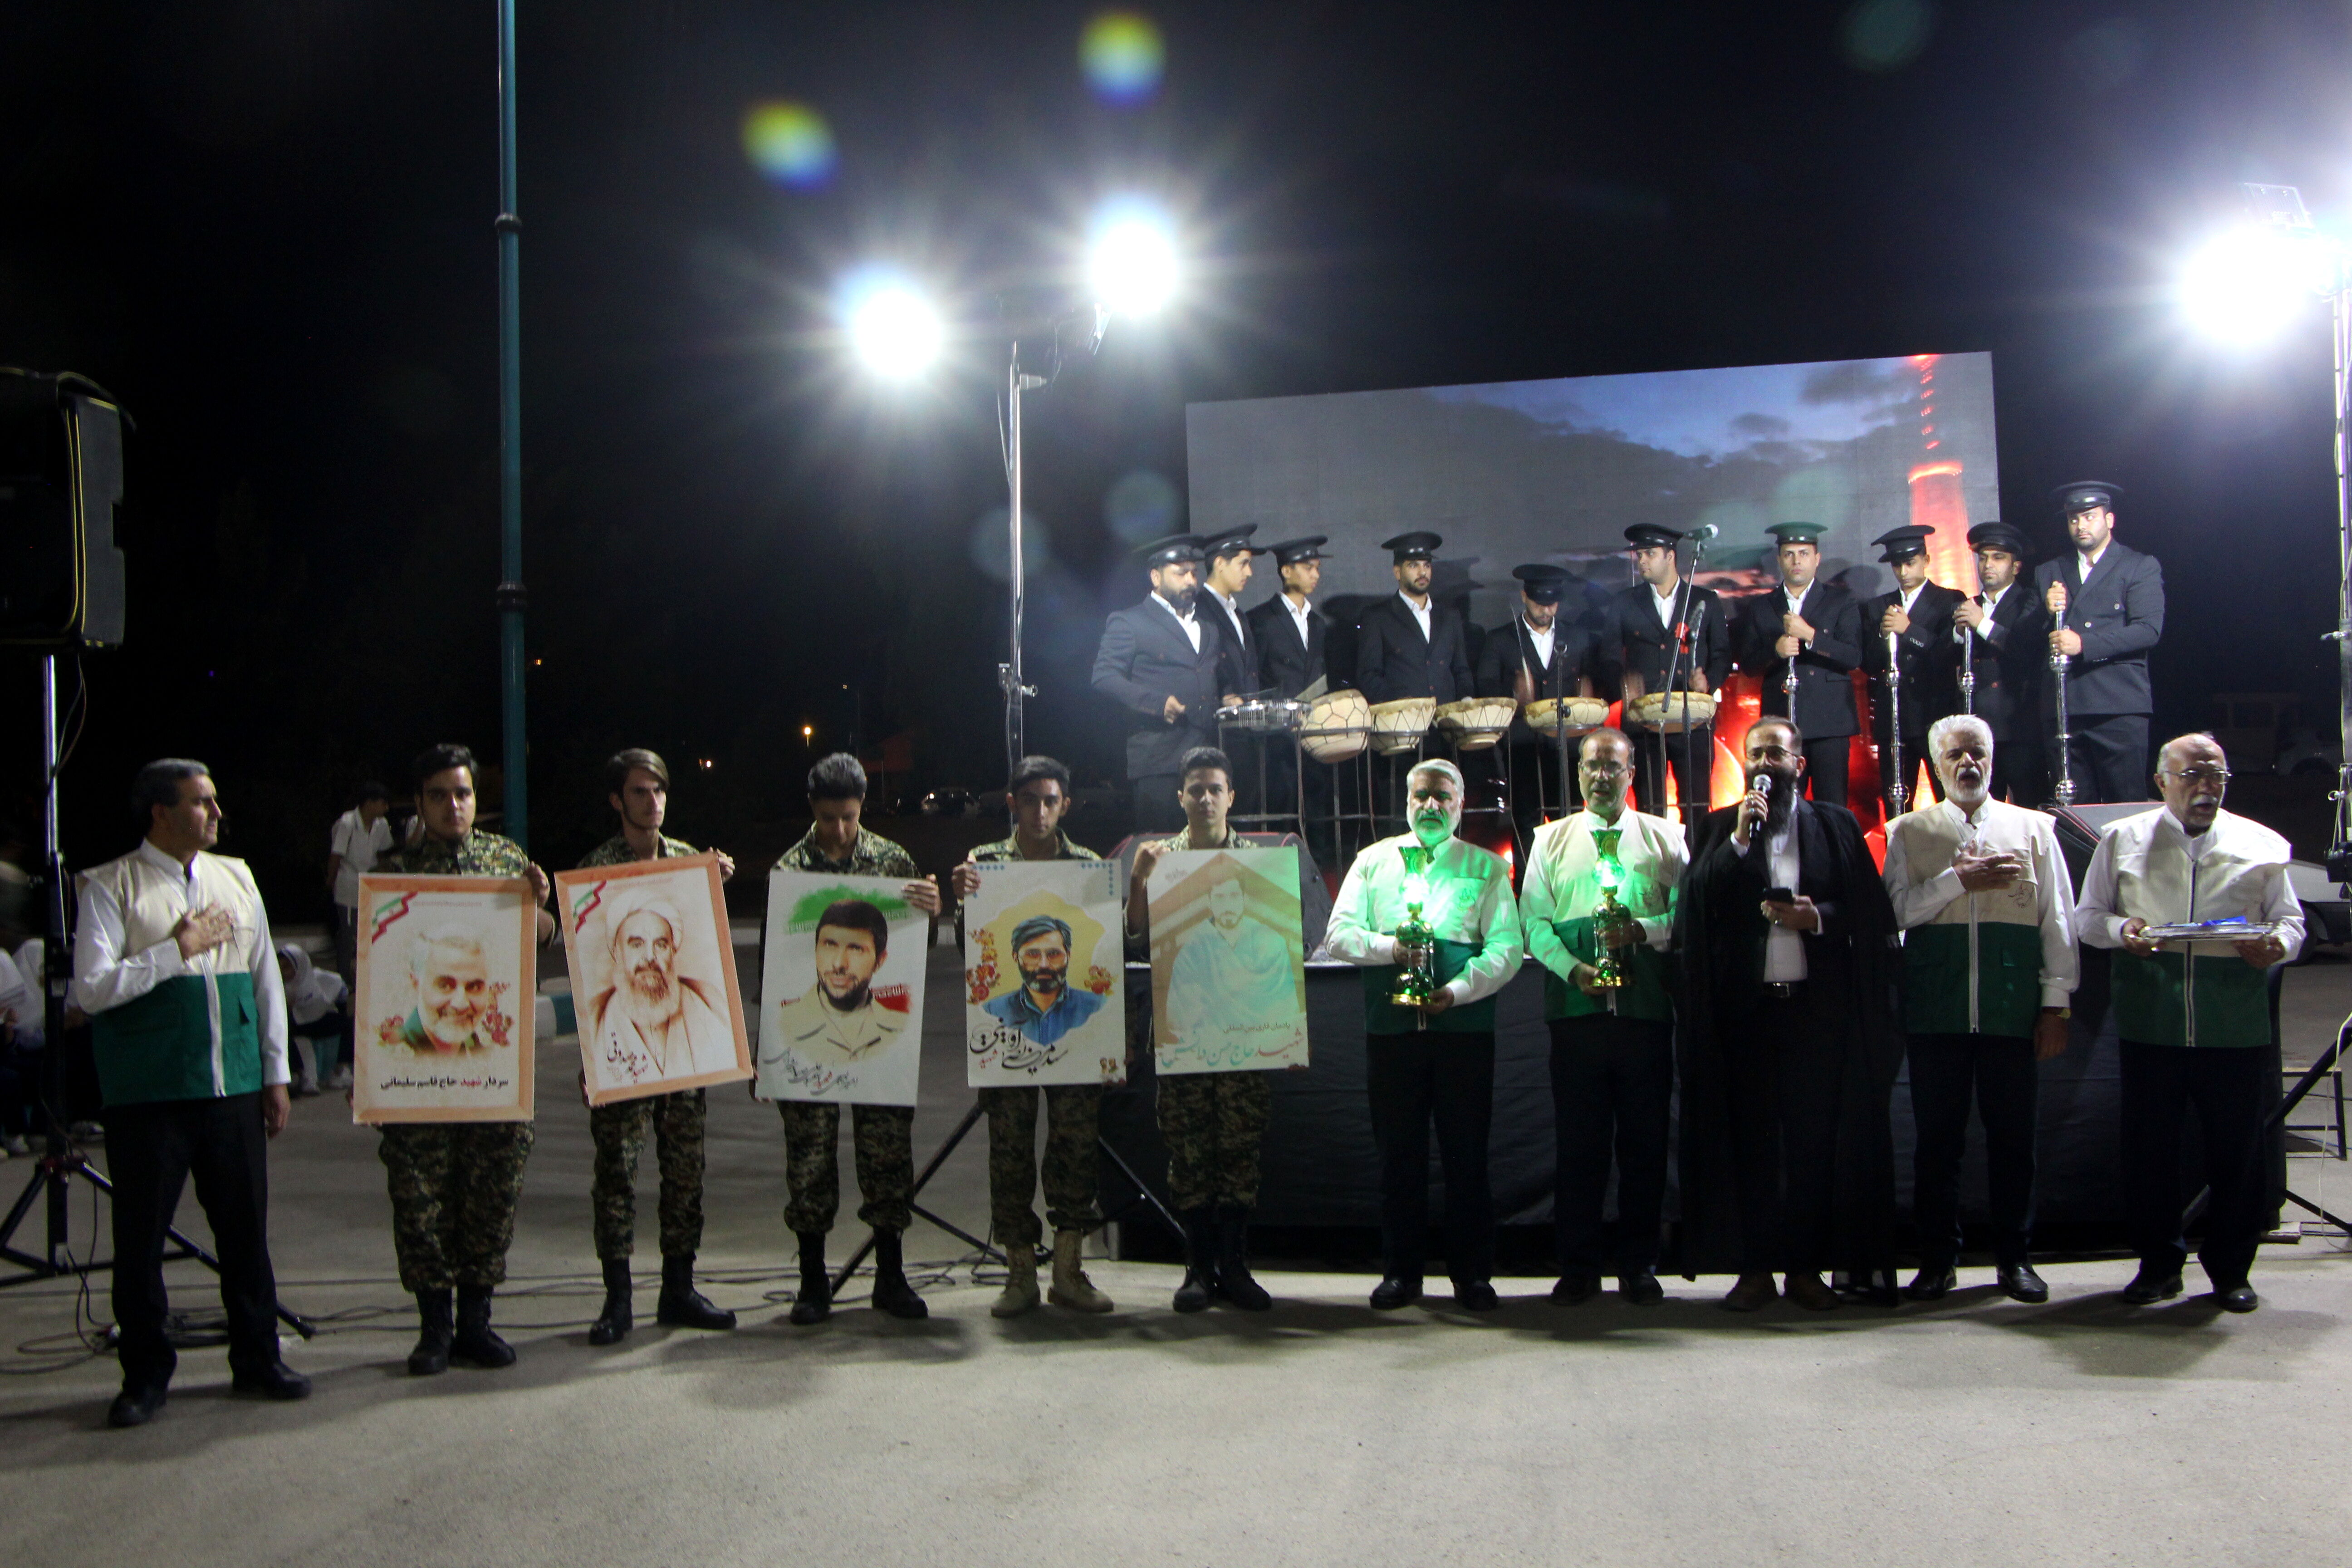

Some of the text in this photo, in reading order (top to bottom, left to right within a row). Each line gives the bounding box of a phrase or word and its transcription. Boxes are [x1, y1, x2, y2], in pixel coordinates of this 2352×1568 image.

[1255, 1028, 1305, 1060] شهید
[381, 1075, 509, 1090] سردار شهید حاج قاسم سلیمانی
